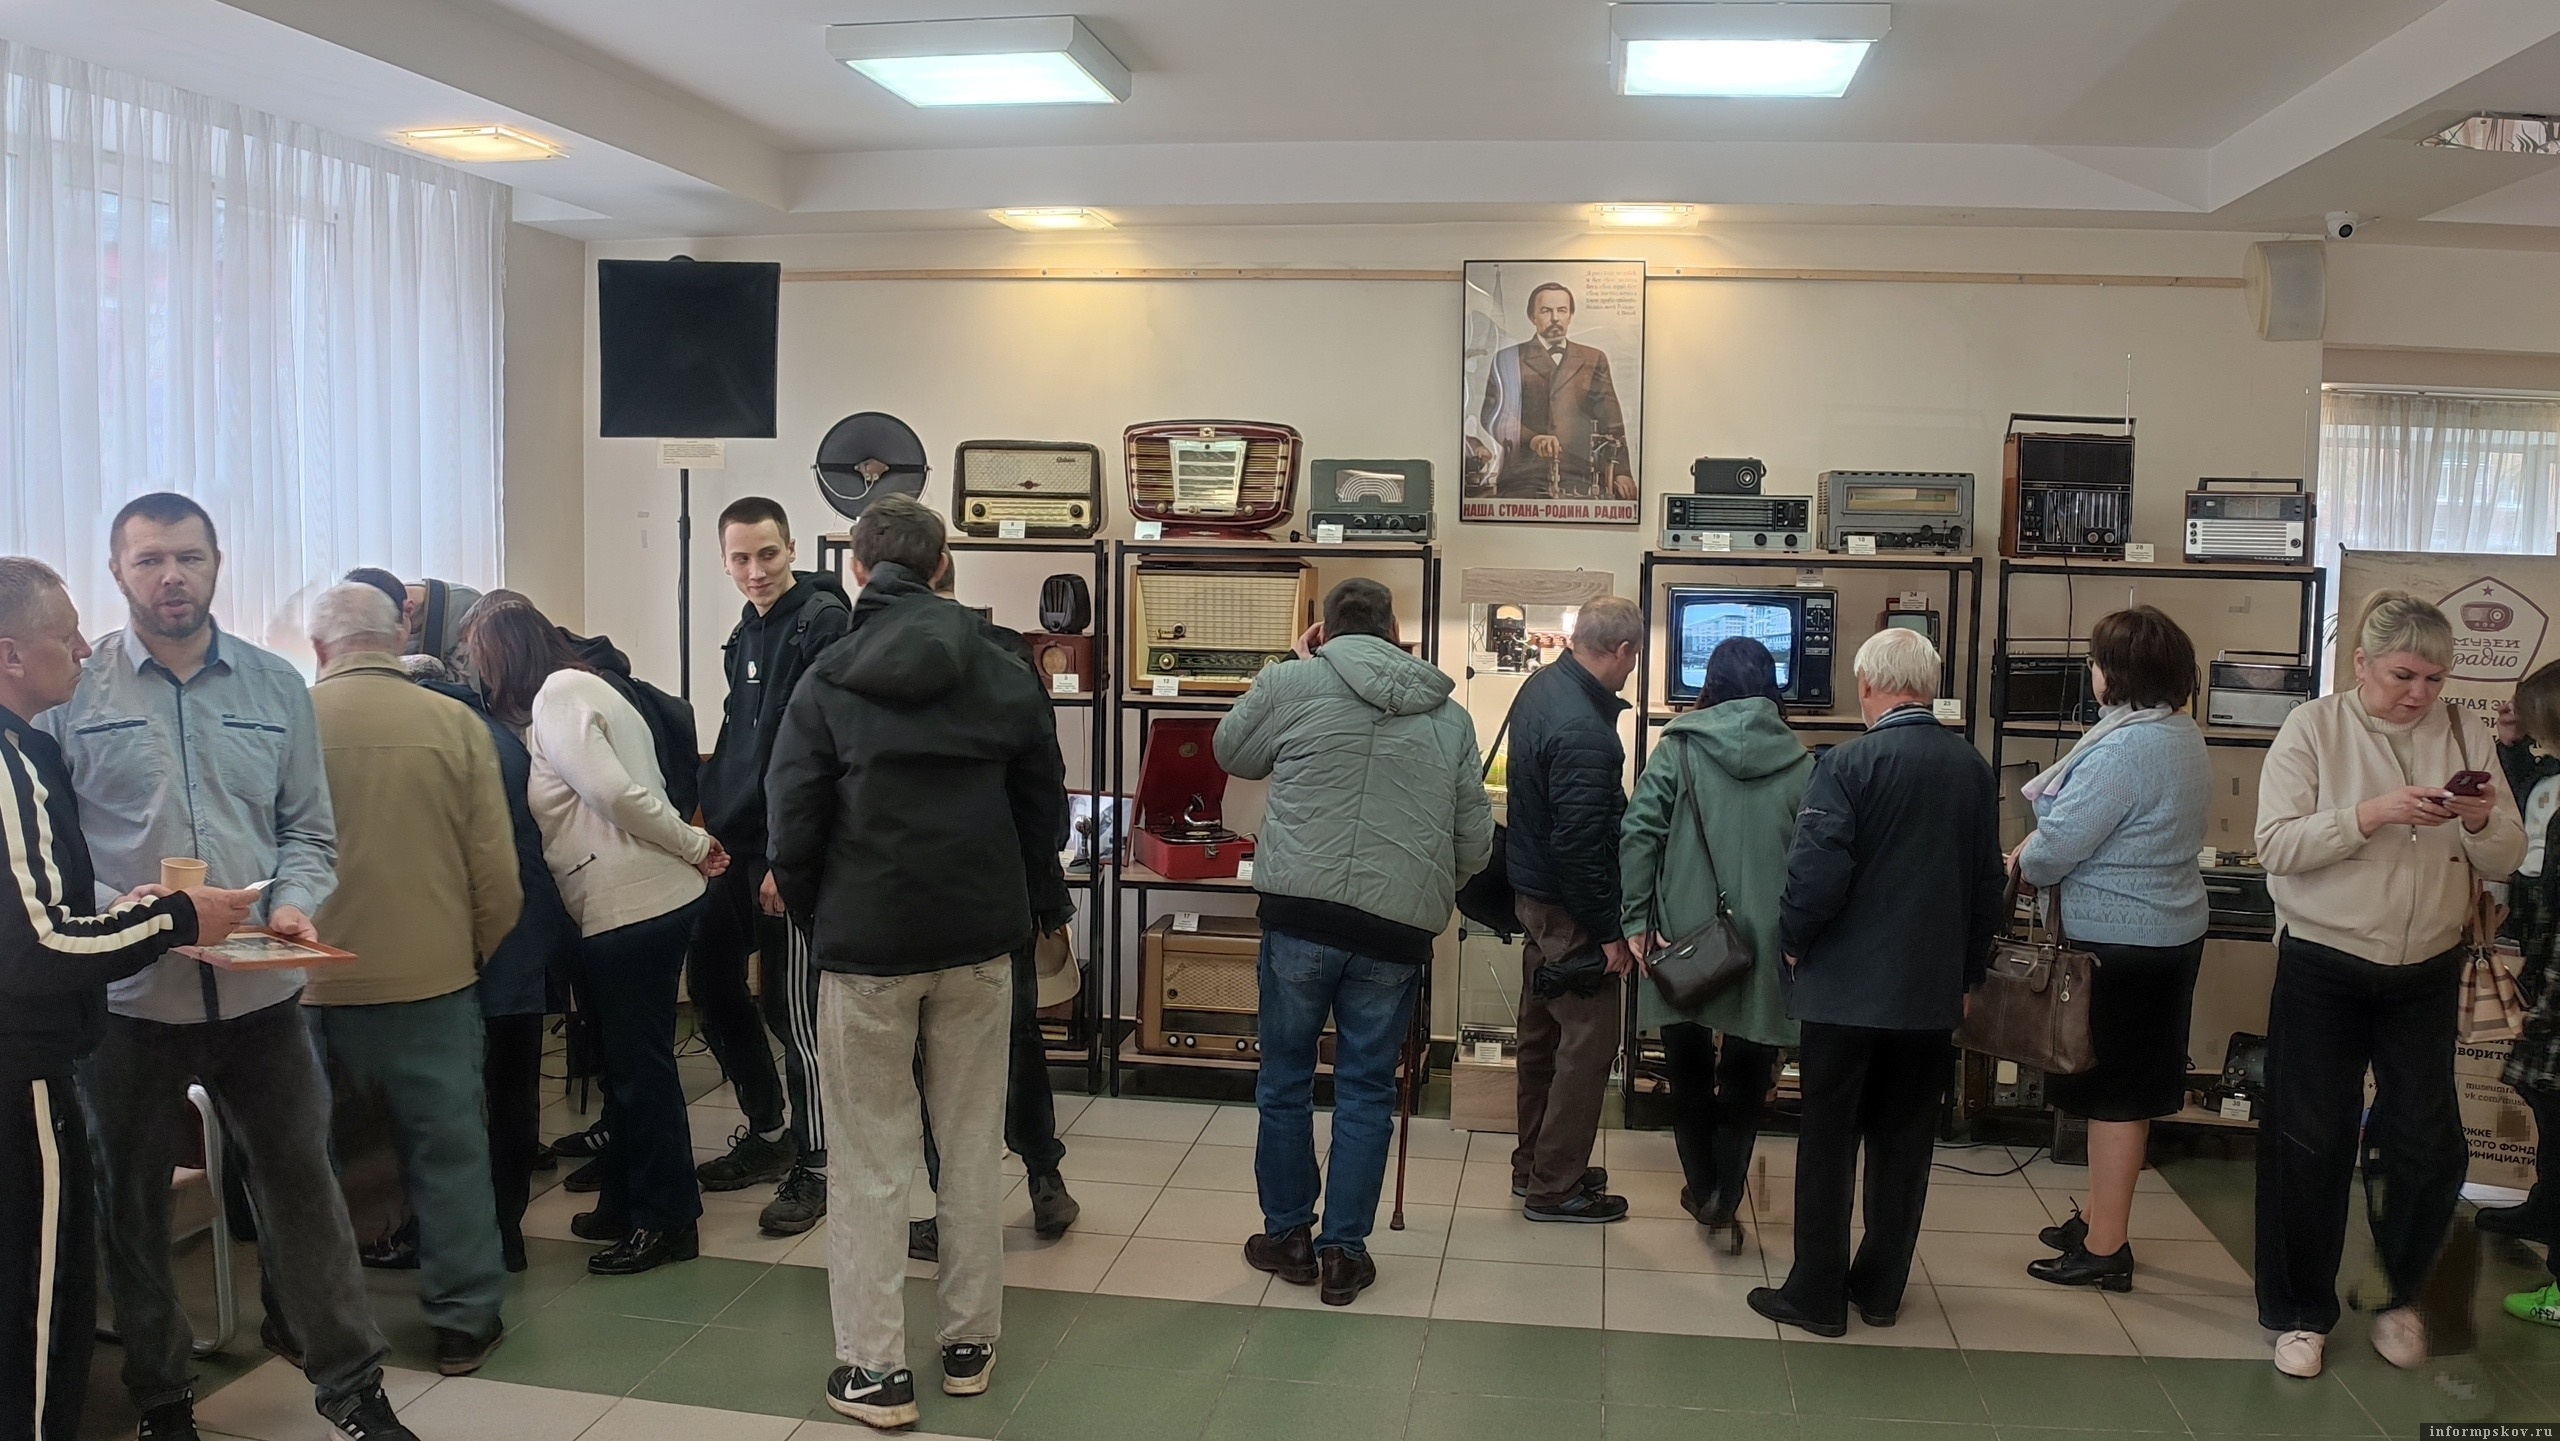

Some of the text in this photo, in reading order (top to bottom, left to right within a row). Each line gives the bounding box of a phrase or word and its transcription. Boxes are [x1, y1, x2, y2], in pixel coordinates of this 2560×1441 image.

[1464, 503, 1637, 520] НАША СТРАНА-РОДИНА РАДИО!
[2452, 648, 2517, 671] радио
[2469, 1150, 2535, 1166] ИНИЦИАТИ
